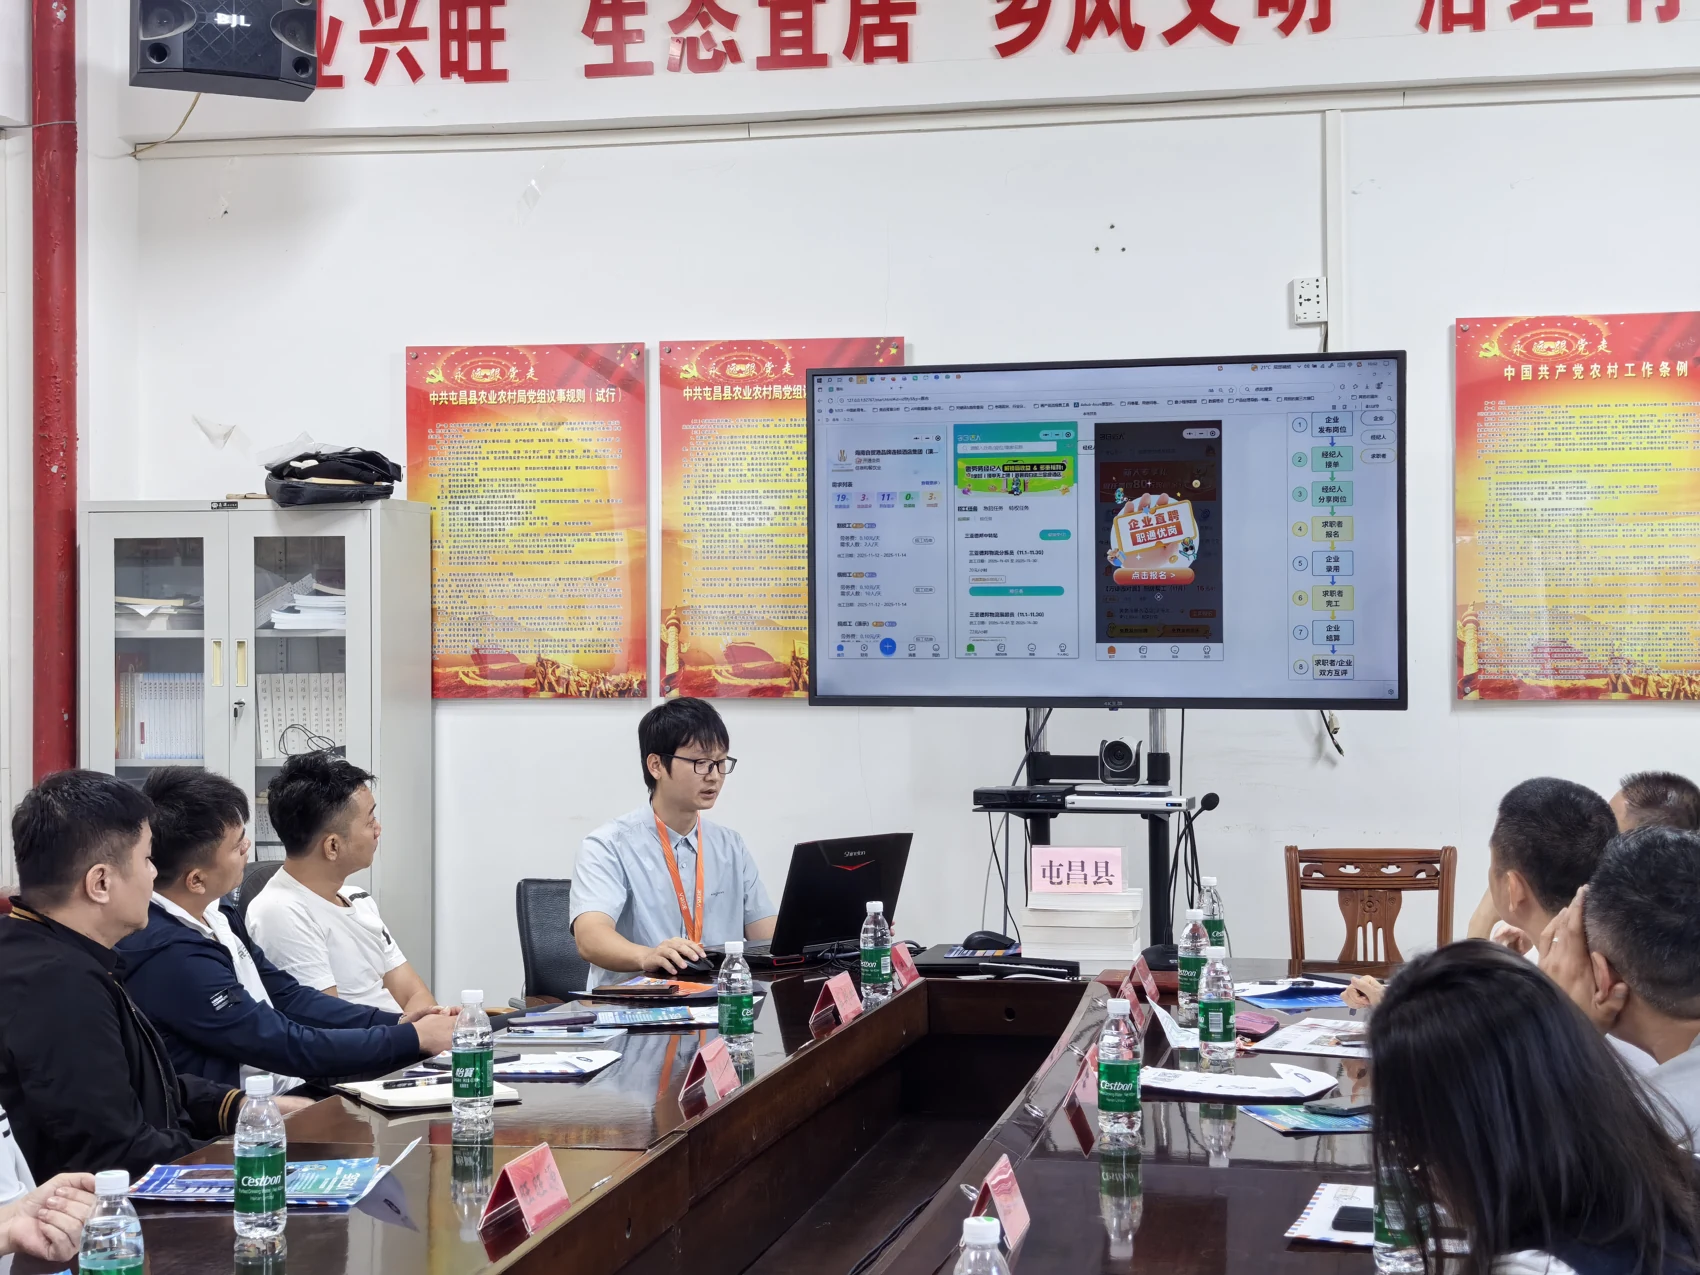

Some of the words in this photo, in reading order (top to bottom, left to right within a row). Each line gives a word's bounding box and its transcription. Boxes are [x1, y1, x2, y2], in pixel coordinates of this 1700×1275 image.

[1504, 360, 1689, 381] 中国共产党农村工作条例
[429, 387, 623, 406] 中共屯昌县农业农村局党组议事规则（试行）
[1128, 509, 1180, 531] 企业直聘
[1136, 525, 1177, 543] 职通优岗
[1132, 571, 1167, 580] 点击报名
[1040, 859, 1115, 886] 屯昌县
